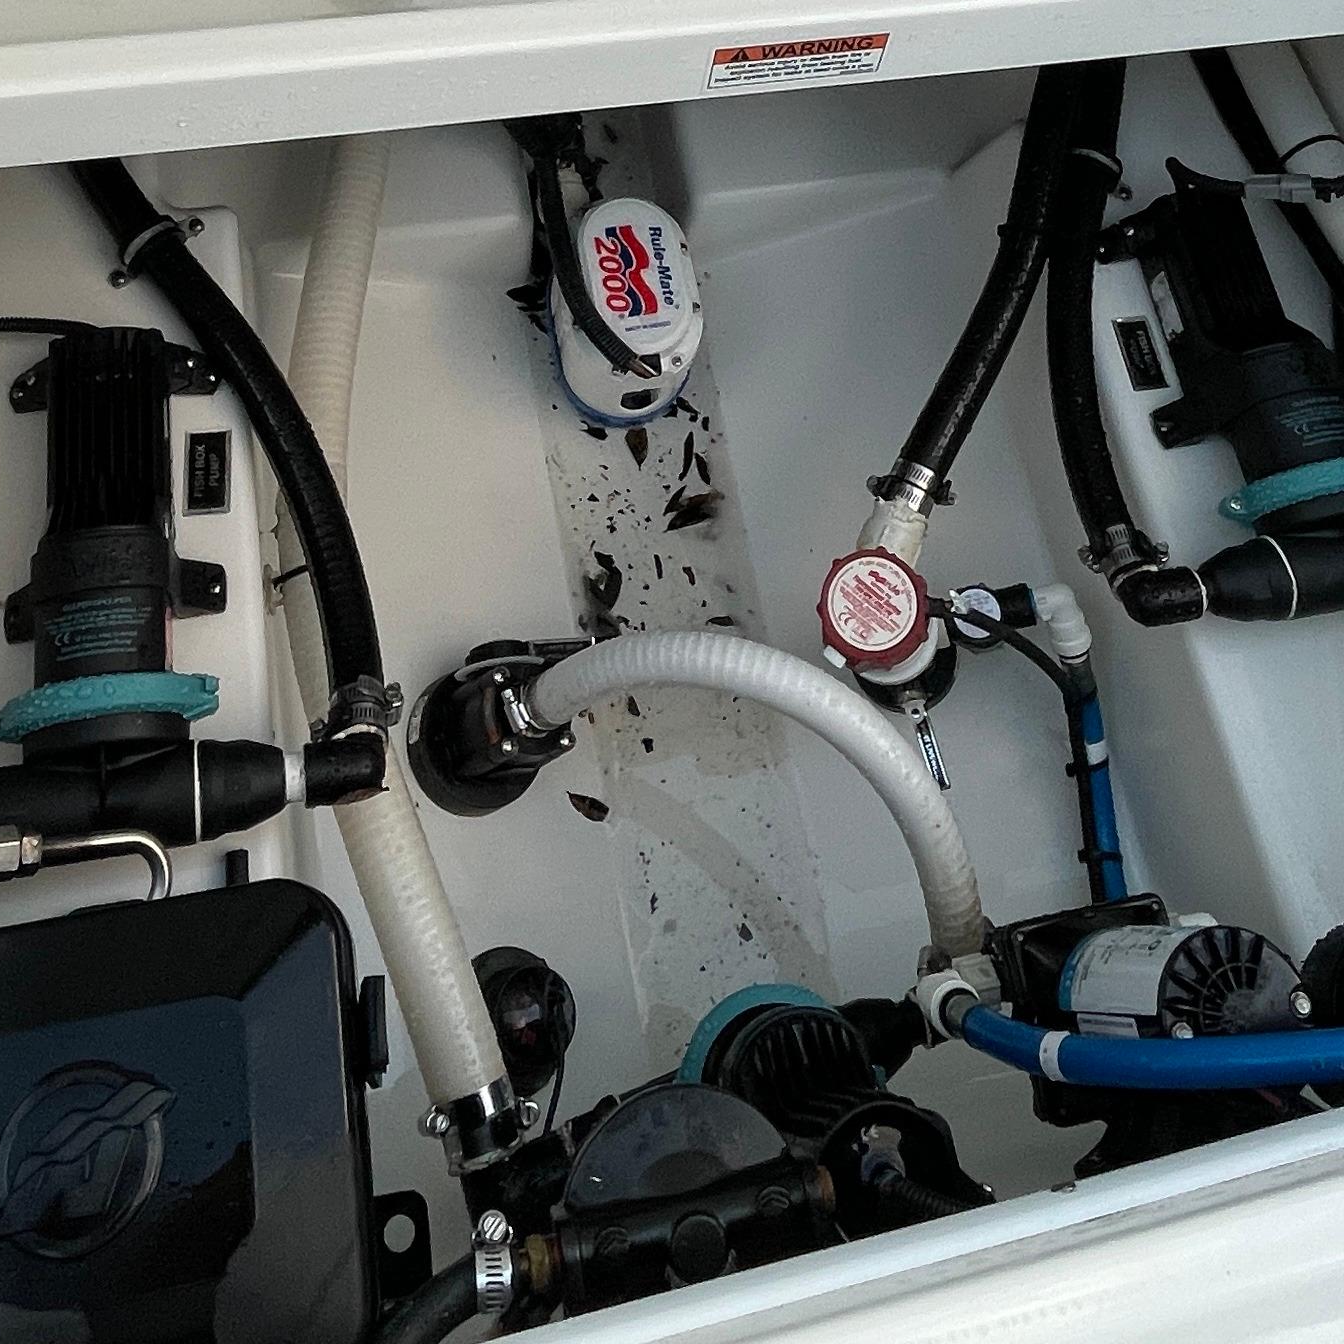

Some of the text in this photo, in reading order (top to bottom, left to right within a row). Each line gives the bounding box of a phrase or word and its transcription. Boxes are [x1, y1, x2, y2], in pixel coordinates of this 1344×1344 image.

[763, 37, 874, 59] WARNING
[593, 236, 631, 313] 2000
[648, 225, 674, 306] Rule-Mate
[194, 444, 206, 498] FISH BOX
[208, 453, 221, 487] PUMP
